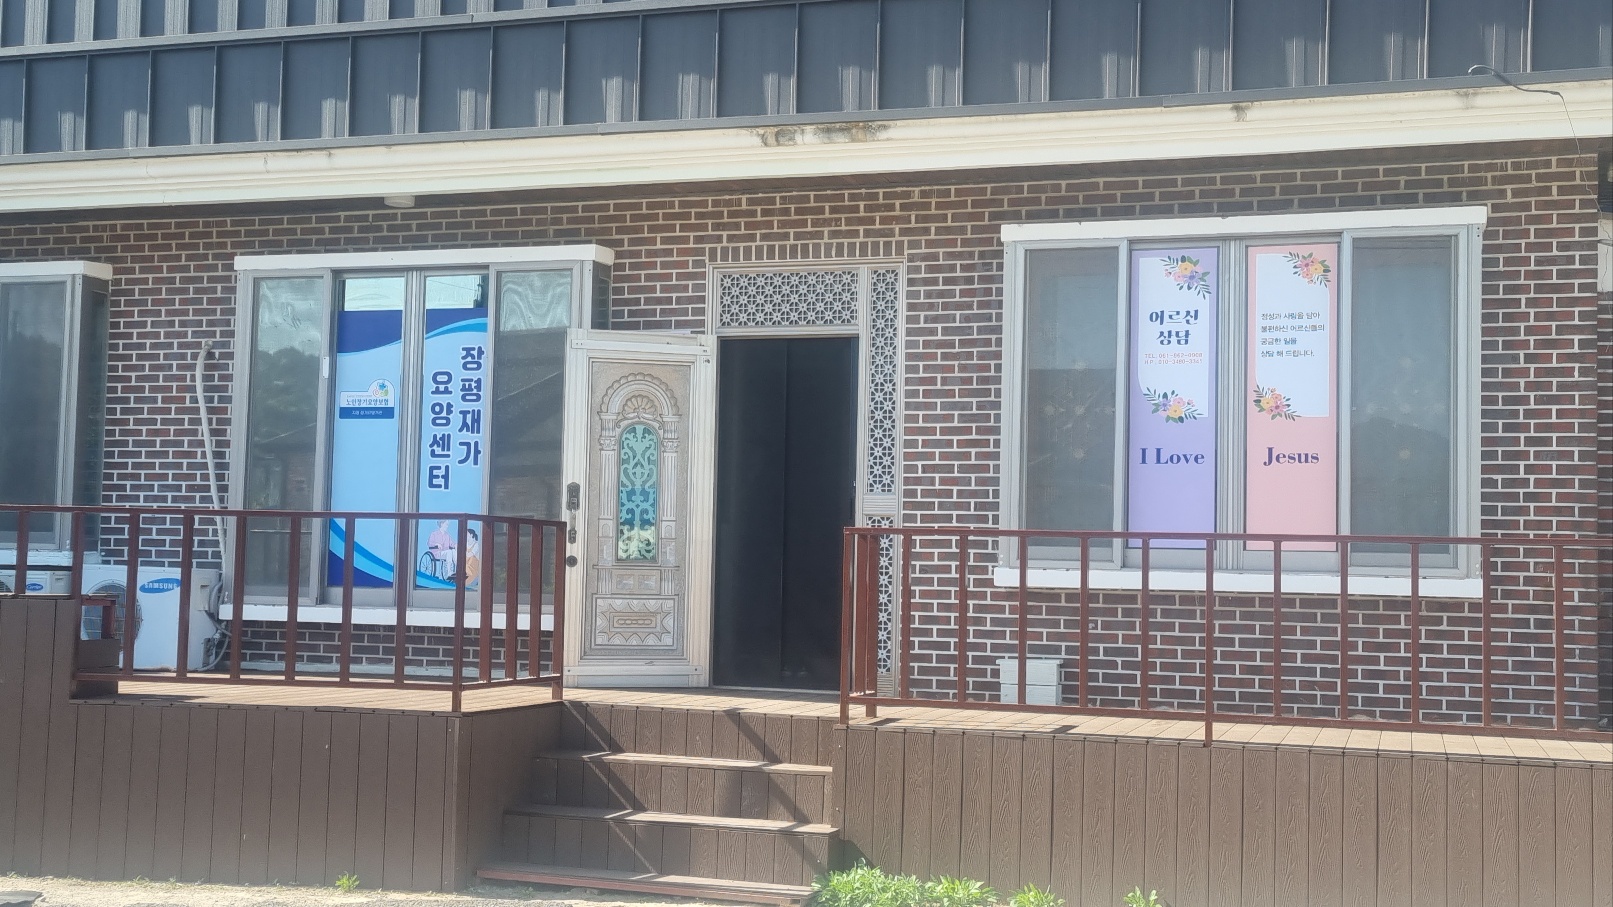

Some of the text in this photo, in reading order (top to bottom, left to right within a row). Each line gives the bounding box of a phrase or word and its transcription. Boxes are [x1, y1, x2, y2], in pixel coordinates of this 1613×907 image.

[1149, 309, 1199, 326] 어르신
[1283, 311, 1304, 320] 사랑을
[1306, 311, 1321, 320] 담아
[1261, 323, 1325, 333] 불편하신 어르신들의
[1156, 329, 1191, 346] 상담
[1260, 337, 1282, 346] 궁금한
[1260, 349, 1315, 358] 상담 해 드립니다.
[457, 345, 485, 466] 장평재가
[428, 370, 454, 490] 요양센터
[1139, 447, 1205, 465] I Love
[1263, 447, 1320, 466] Jesus
[144, 582, 178, 590] SAMSUNG
